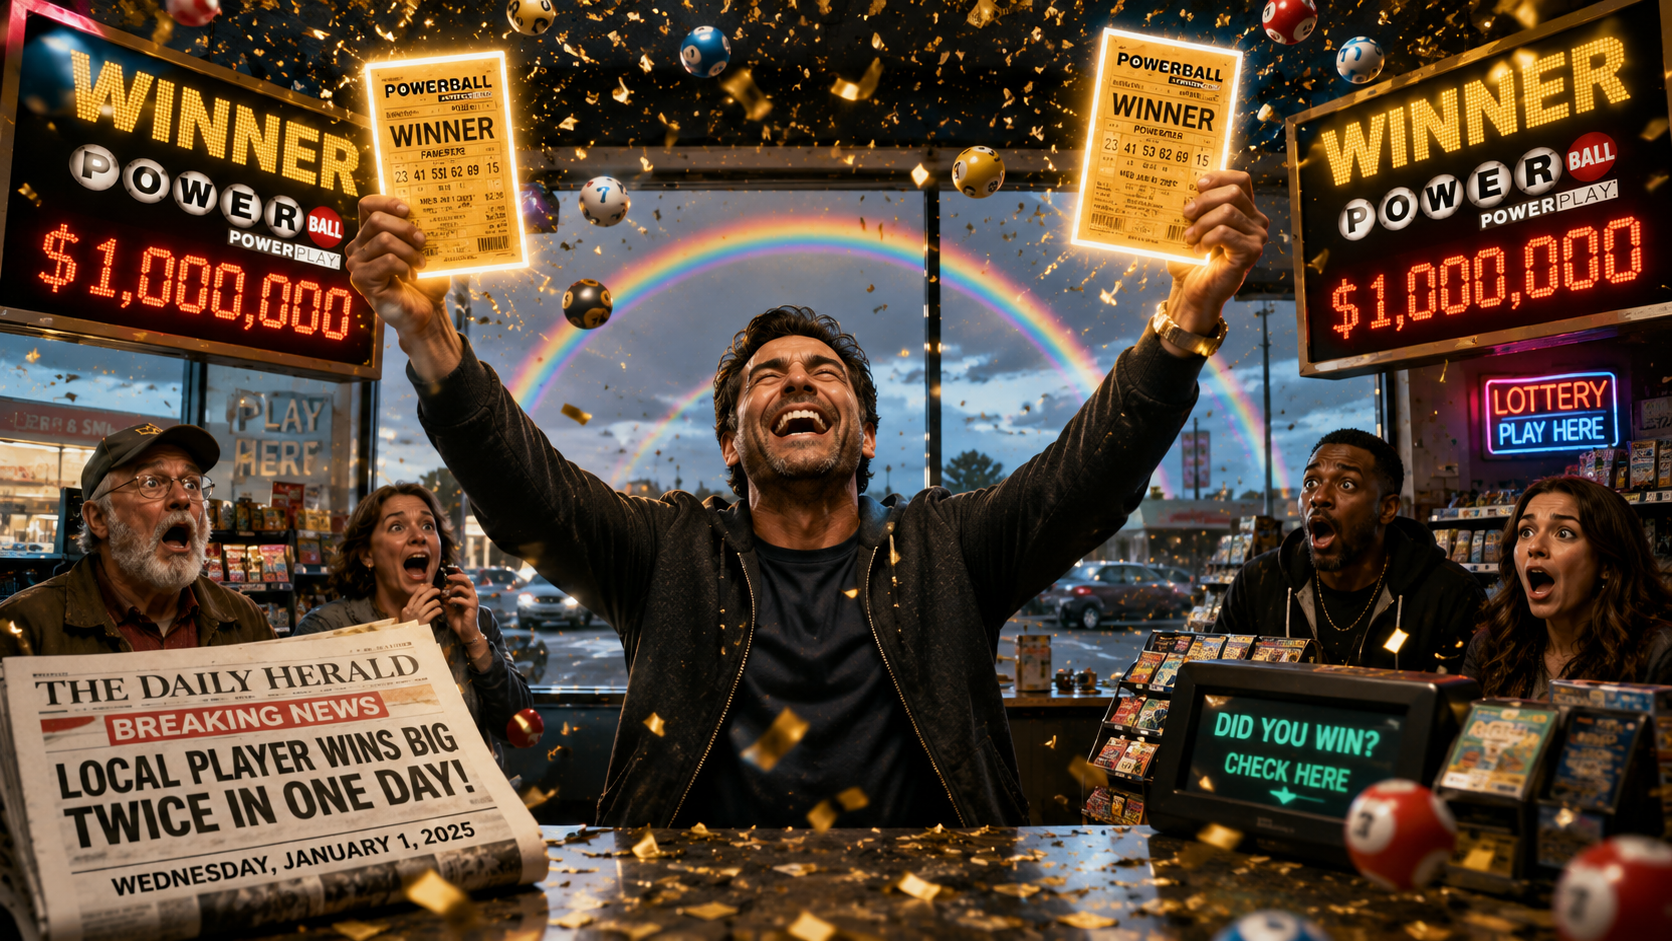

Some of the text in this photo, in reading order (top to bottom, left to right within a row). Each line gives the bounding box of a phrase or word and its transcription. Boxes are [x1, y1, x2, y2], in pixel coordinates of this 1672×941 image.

[384, 75, 492, 98] POWERBALL
[1117, 52, 1223, 82] POWERBALL
[70, 48, 359, 197] WINNER
[389, 116, 495, 148] WINNER
[1112, 92, 1216, 133] WINNER
[1321, 36, 1631, 186] WINNER
[395, 171, 408, 183] 23
[414, 169, 426, 181] 41
[451, 165, 463, 178] 62
[486, 161, 500, 174] 15
[1104, 137, 1210, 168] 23 41 53 62 69 15
[38, 223, 352, 341] $1,000,000
[1332, 216, 1642, 339] $1,000,000
[237, 395, 328, 434] PLAY
[1493, 379, 1608, 415] LOTTERY
[1498, 416, 1606, 446] PLAY HERE
[35, 678, 129, 706] THE
[136, 669, 253, 700] DAILY
[261, 654, 420, 690] HERALD
[112, 696, 380, 741] BREAKING NEWS
[1214, 712, 1380, 757] DID YOU WIN?
[56, 722, 459, 799] LOCAL PLAYER WINS BIG
[1224, 752, 1352, 793] CHECK HERE
[64, 759, 476, 848] TWICE IN ONE DAY!
[111, 821, 476, 897] WEDNESDAY, JANUARY 1, 2025
